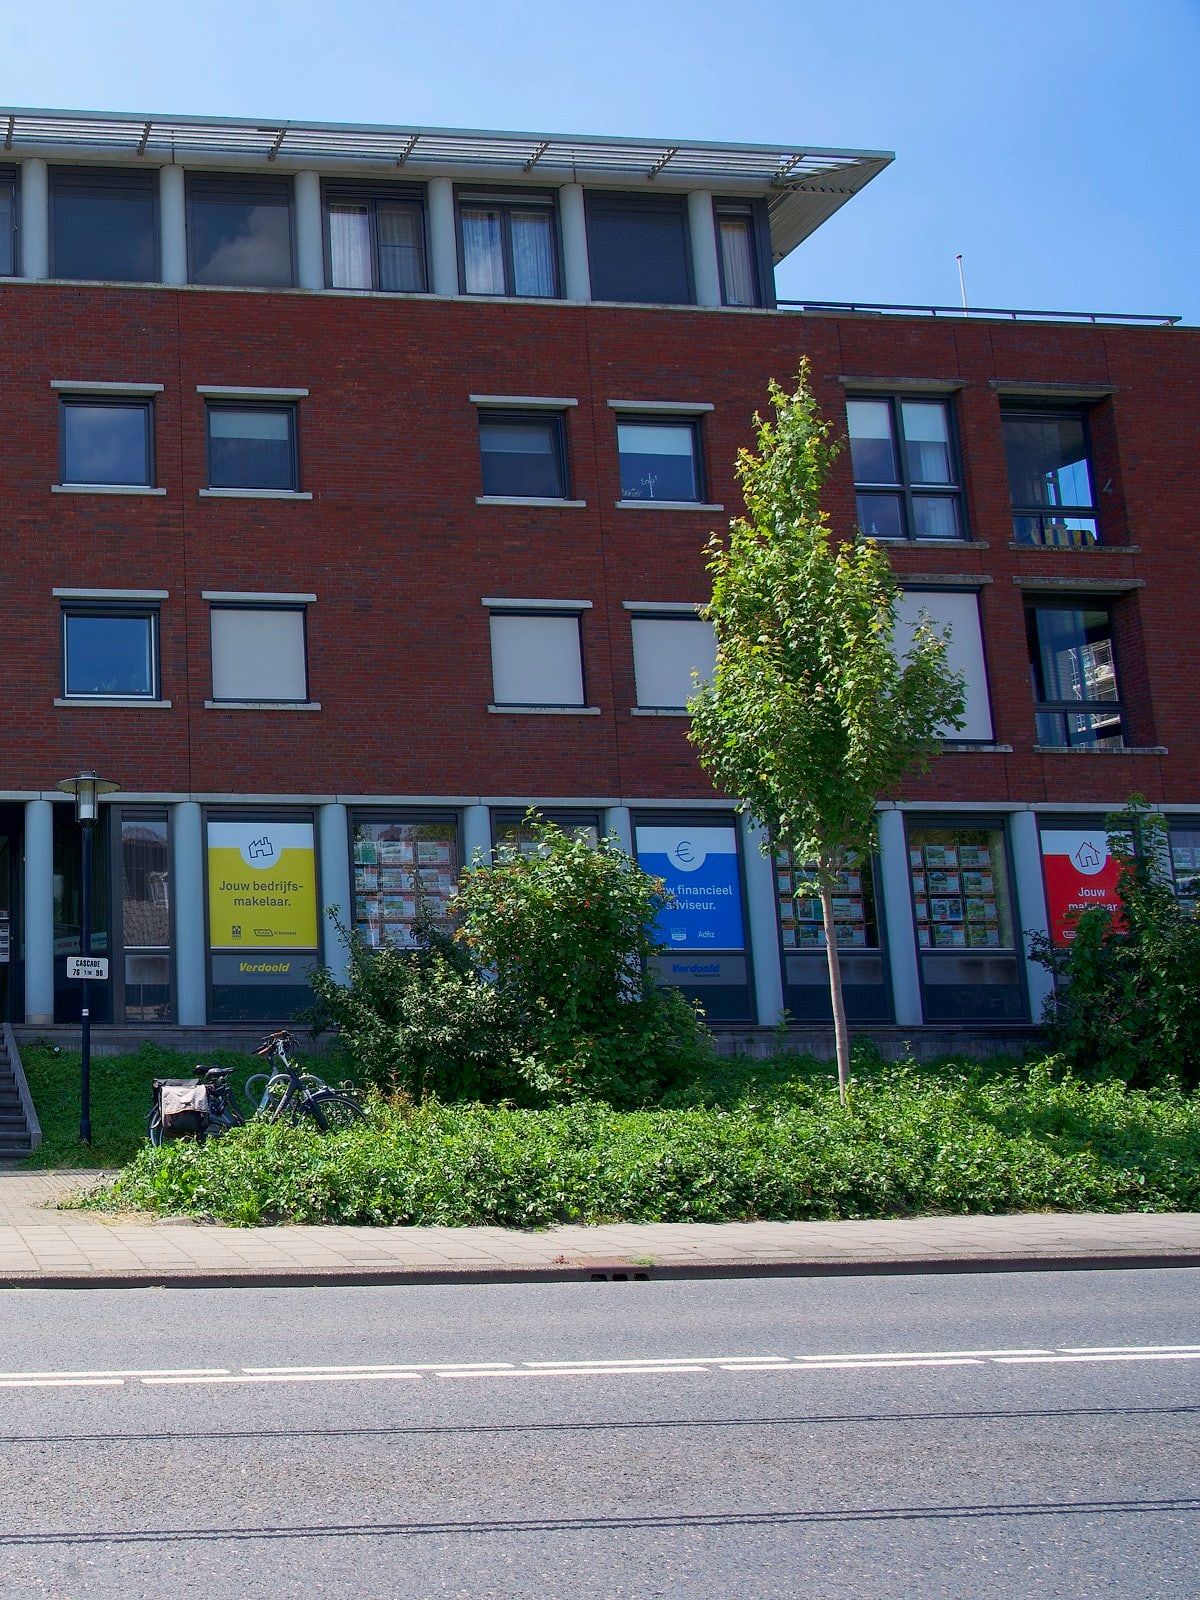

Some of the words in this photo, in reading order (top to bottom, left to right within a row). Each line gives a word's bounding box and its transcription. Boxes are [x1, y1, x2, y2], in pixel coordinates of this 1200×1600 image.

[219, 881, 250, 892] Jouw
[252, 880, 304, 893] bedrijfs-
[677, 885, 733, 896] financieel
[1078, 887, 1106, 897] Jouw
[233, 895, 292, 907] makelaar.
[75, 959, 101, 968] CASCADE
[238, 962, 290, 973] Verdoold
[672, 963, 721, 973] Verdoold
